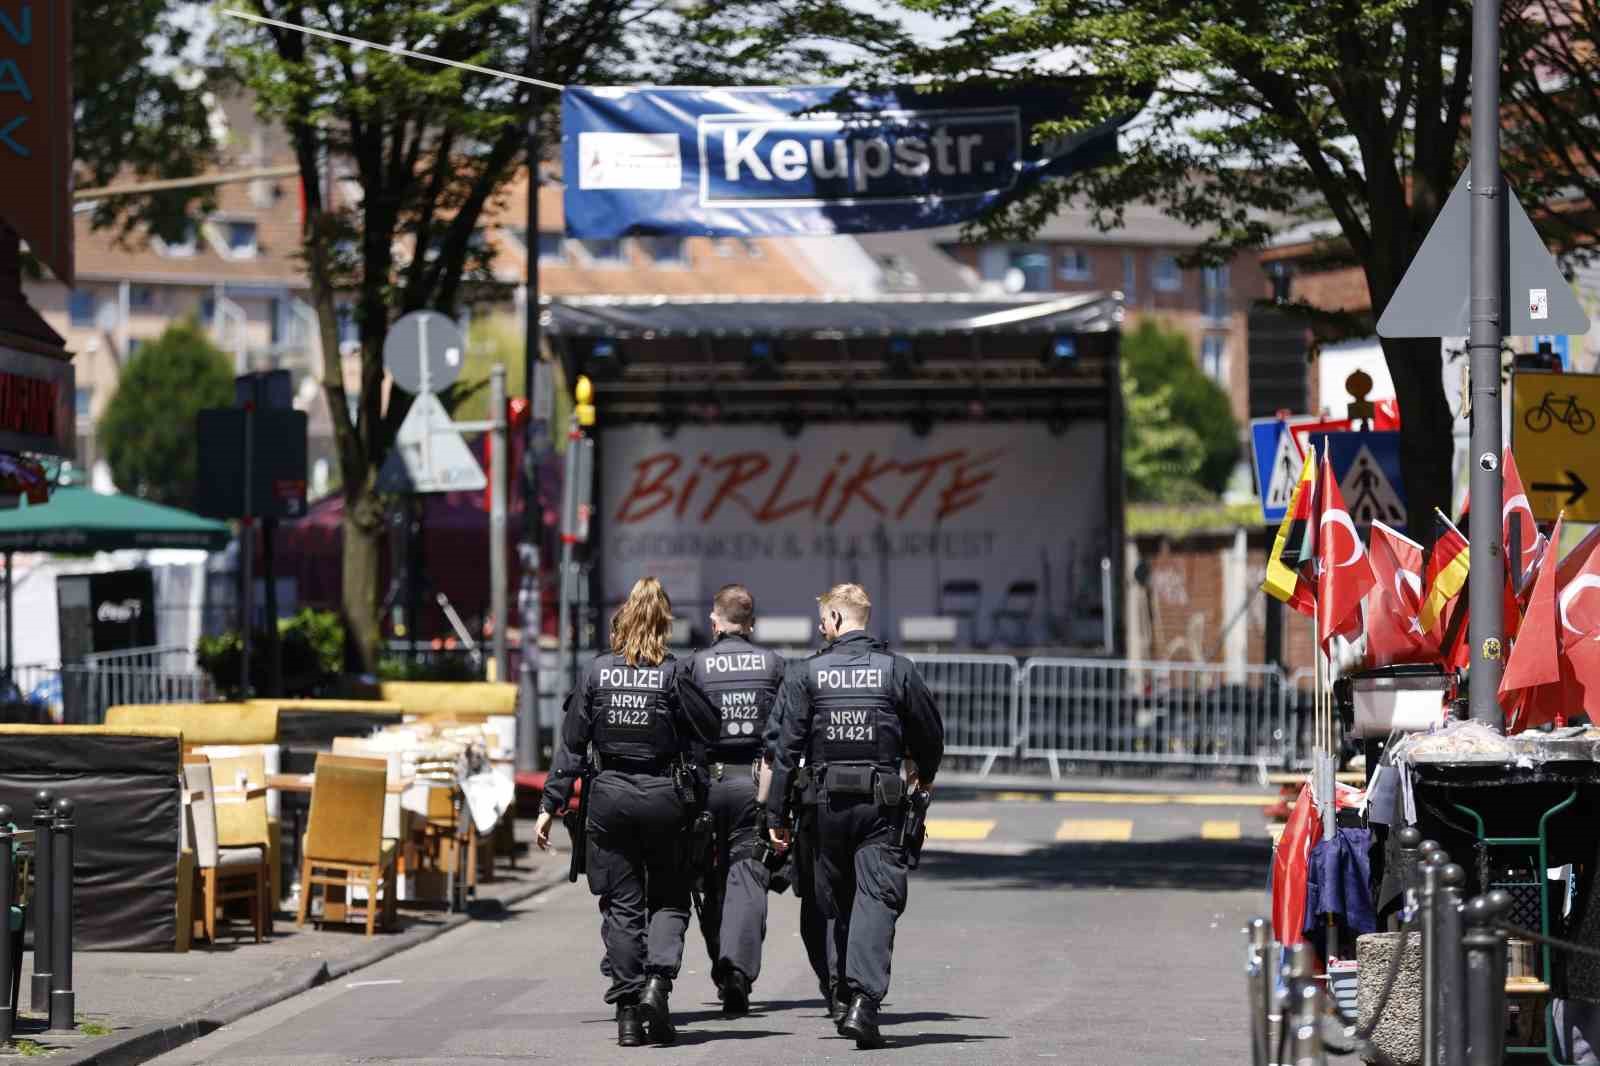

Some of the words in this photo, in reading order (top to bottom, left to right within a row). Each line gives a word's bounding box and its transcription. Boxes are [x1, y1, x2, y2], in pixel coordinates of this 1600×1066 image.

[722, 126, 996, 193] Keupstr.
[706, 655, 766, 673] POLIZEI
[599, 669, 664, 688] POLIZEI
[817, 669, 882, 689] POLIZEI
[611, 694, 648, 708] NRW
[722, 692, 756, 705] NRW
[608, 710, 649, 725] 31422
[721, 706, 758, 720] 31422
[830, 711, 867, 724] NRW
[826, 726, 873, 741] 31421
